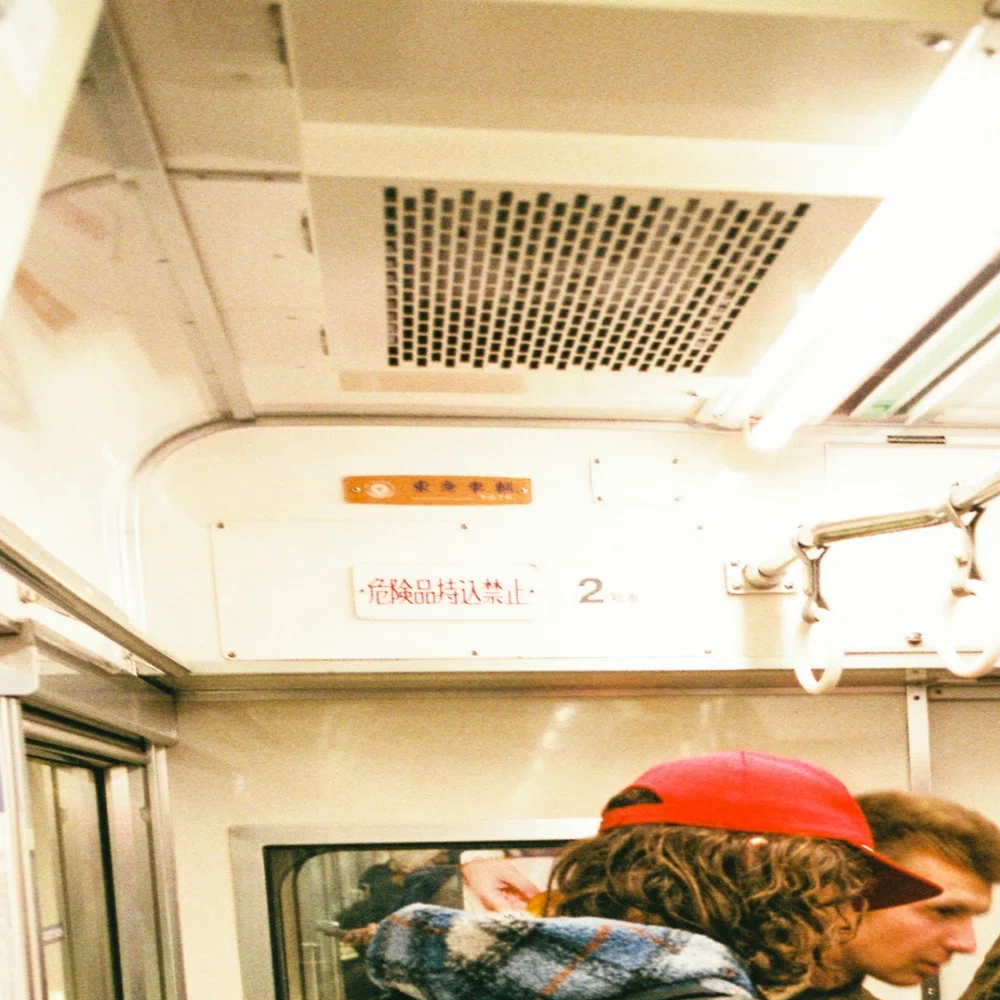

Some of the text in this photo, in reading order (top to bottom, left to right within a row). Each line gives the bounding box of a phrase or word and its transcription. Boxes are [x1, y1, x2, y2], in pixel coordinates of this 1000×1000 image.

[367, 578, 526, 605] 危険品持込禁止
